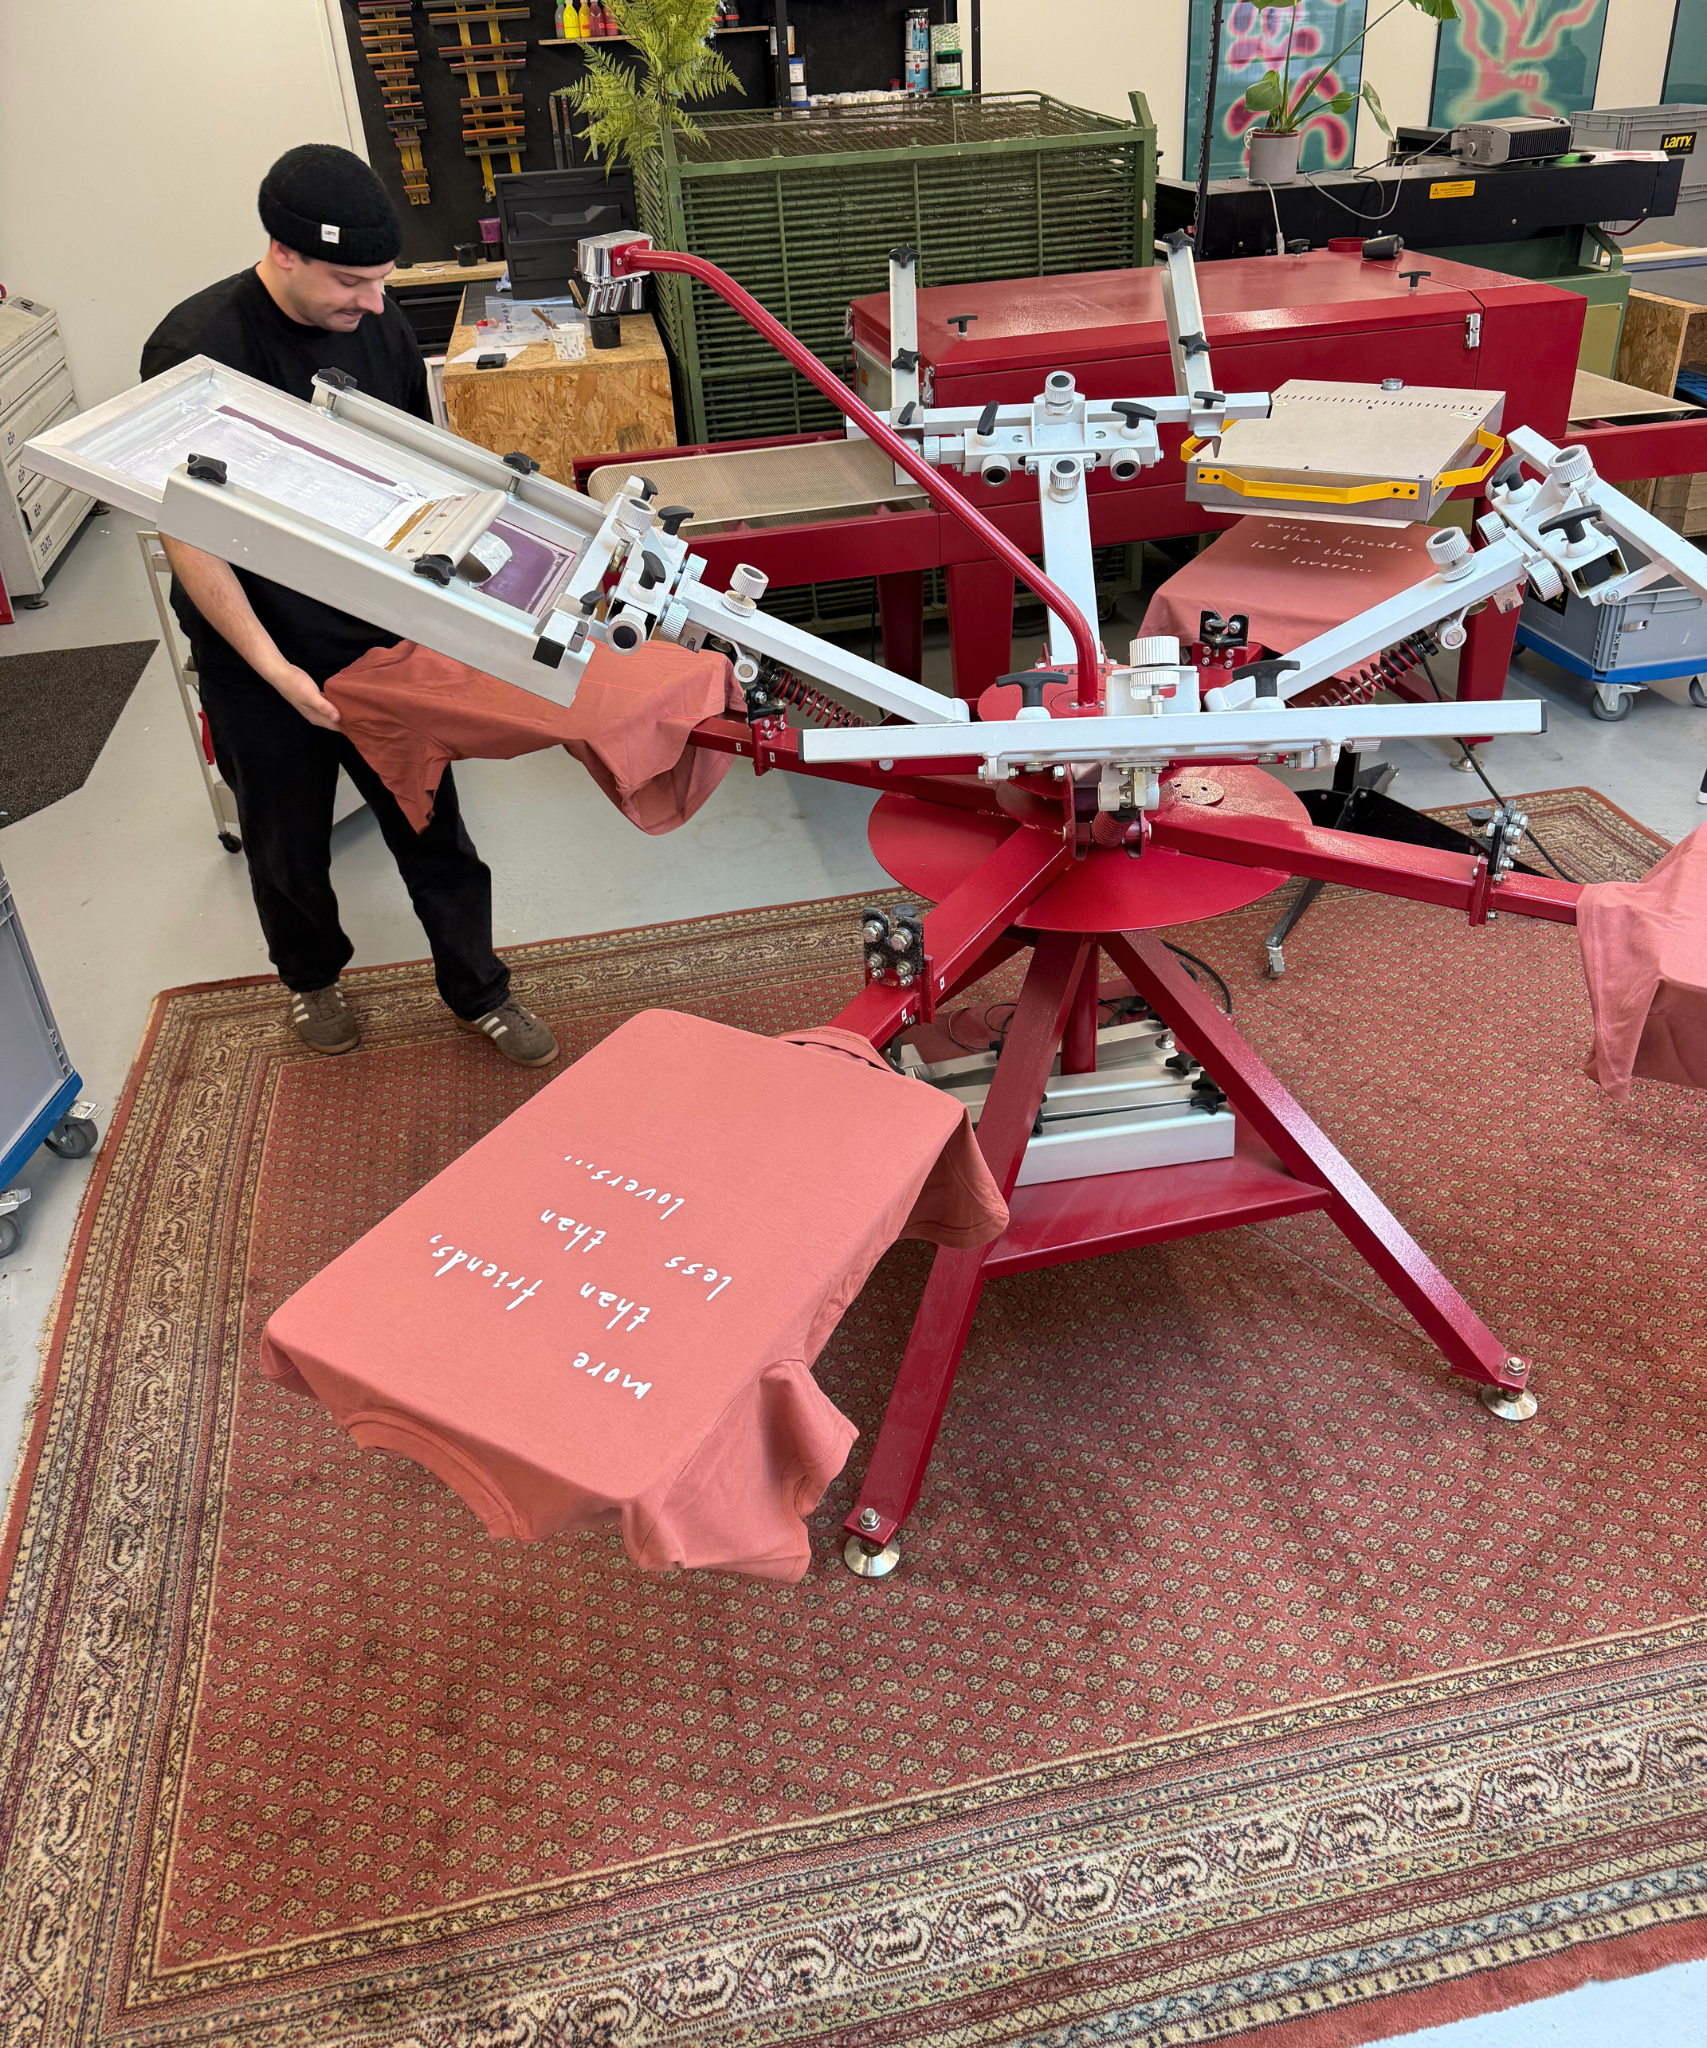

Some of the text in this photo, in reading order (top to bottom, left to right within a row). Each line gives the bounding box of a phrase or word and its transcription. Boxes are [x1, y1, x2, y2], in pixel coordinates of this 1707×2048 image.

[1267, 523, 1307, 532] more
[1283, 534, 1322, 544] than
[1250, 540, 1364, 559] less than
[1291, 556, 1372, 573] lovers...
[540, 1209, 732, 1301] less than
[430, 1234, 651, 1332] than friends,
[573, 1352, 652, 1399] more
